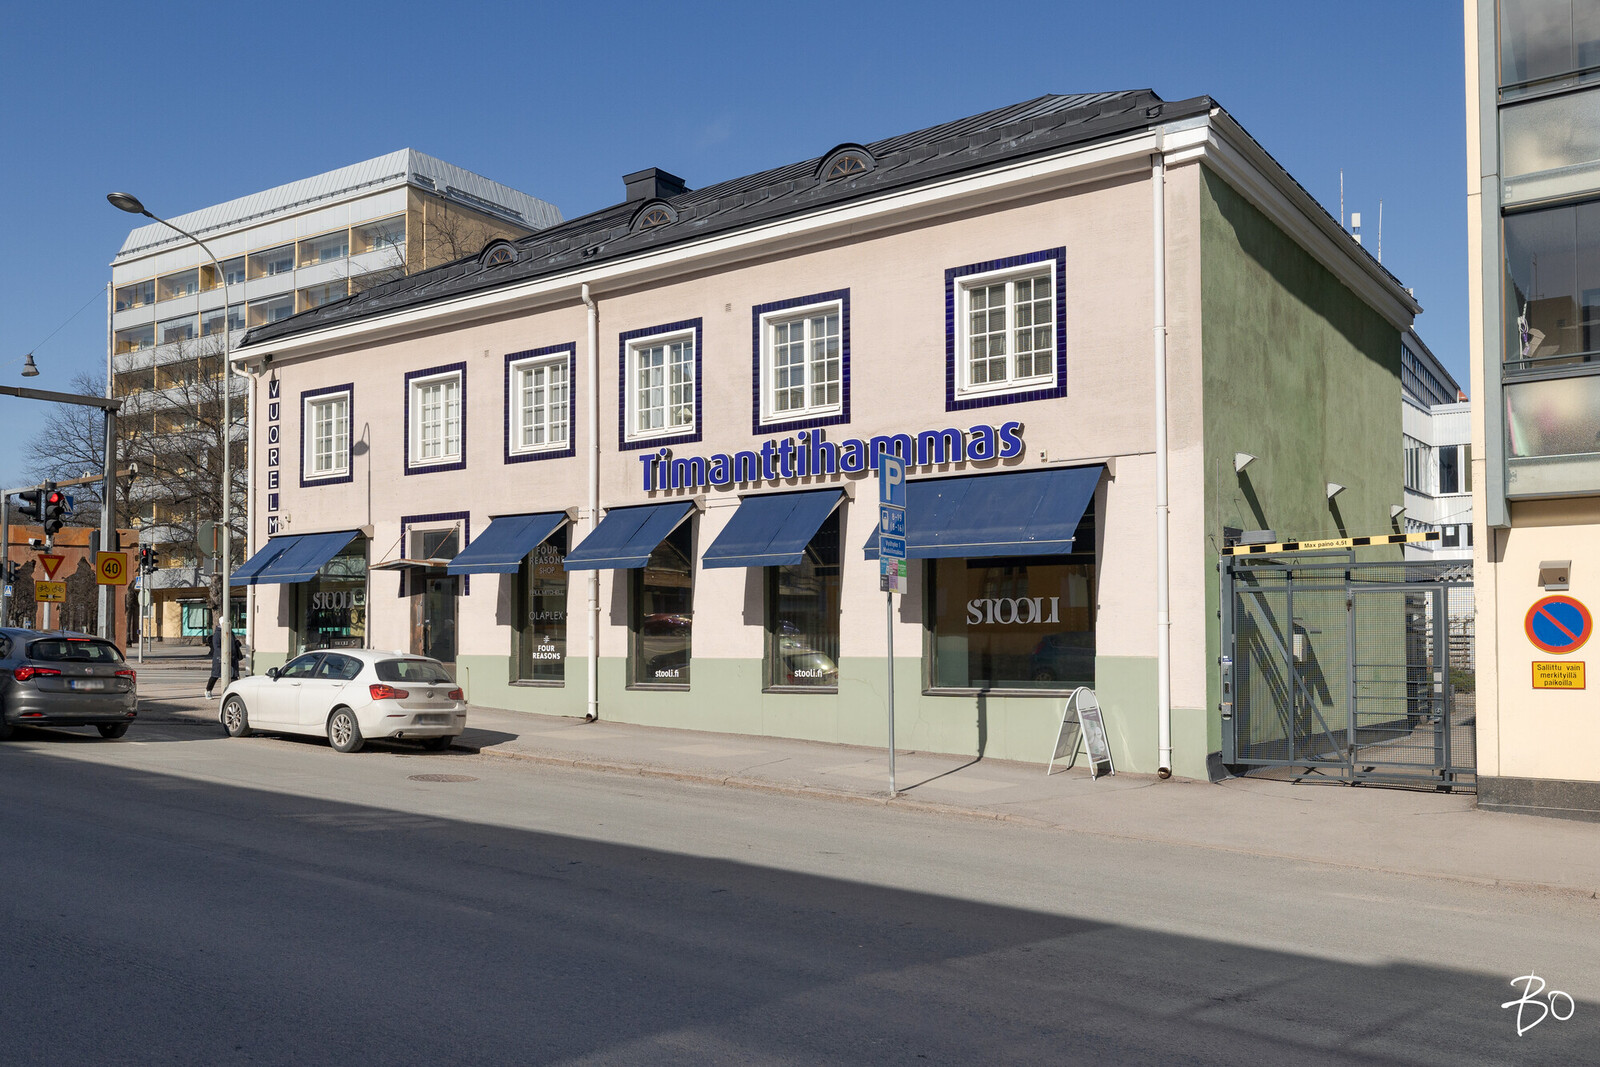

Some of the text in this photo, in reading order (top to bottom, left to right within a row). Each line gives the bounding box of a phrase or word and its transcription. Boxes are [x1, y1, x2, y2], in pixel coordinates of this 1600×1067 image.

[269, 380, 279, 534] VUORELM
[639, 421, 1024, 492] Timanttihammas
[885, 459, 902, 500] P
[536, 546, 558, 554] FOUR
[105, 562, 118, 574] 40
[966, 597, 1060, 624] STOOLI
[529, 611, 564, 620] OLAPLEX
[532, 652, 561, 660] REASONS
[655, 669, 680, 678] stooli.fi
[794, 669, 823, 678] stooli.fi
[1544, 679, 1573, 687] paikoilla
